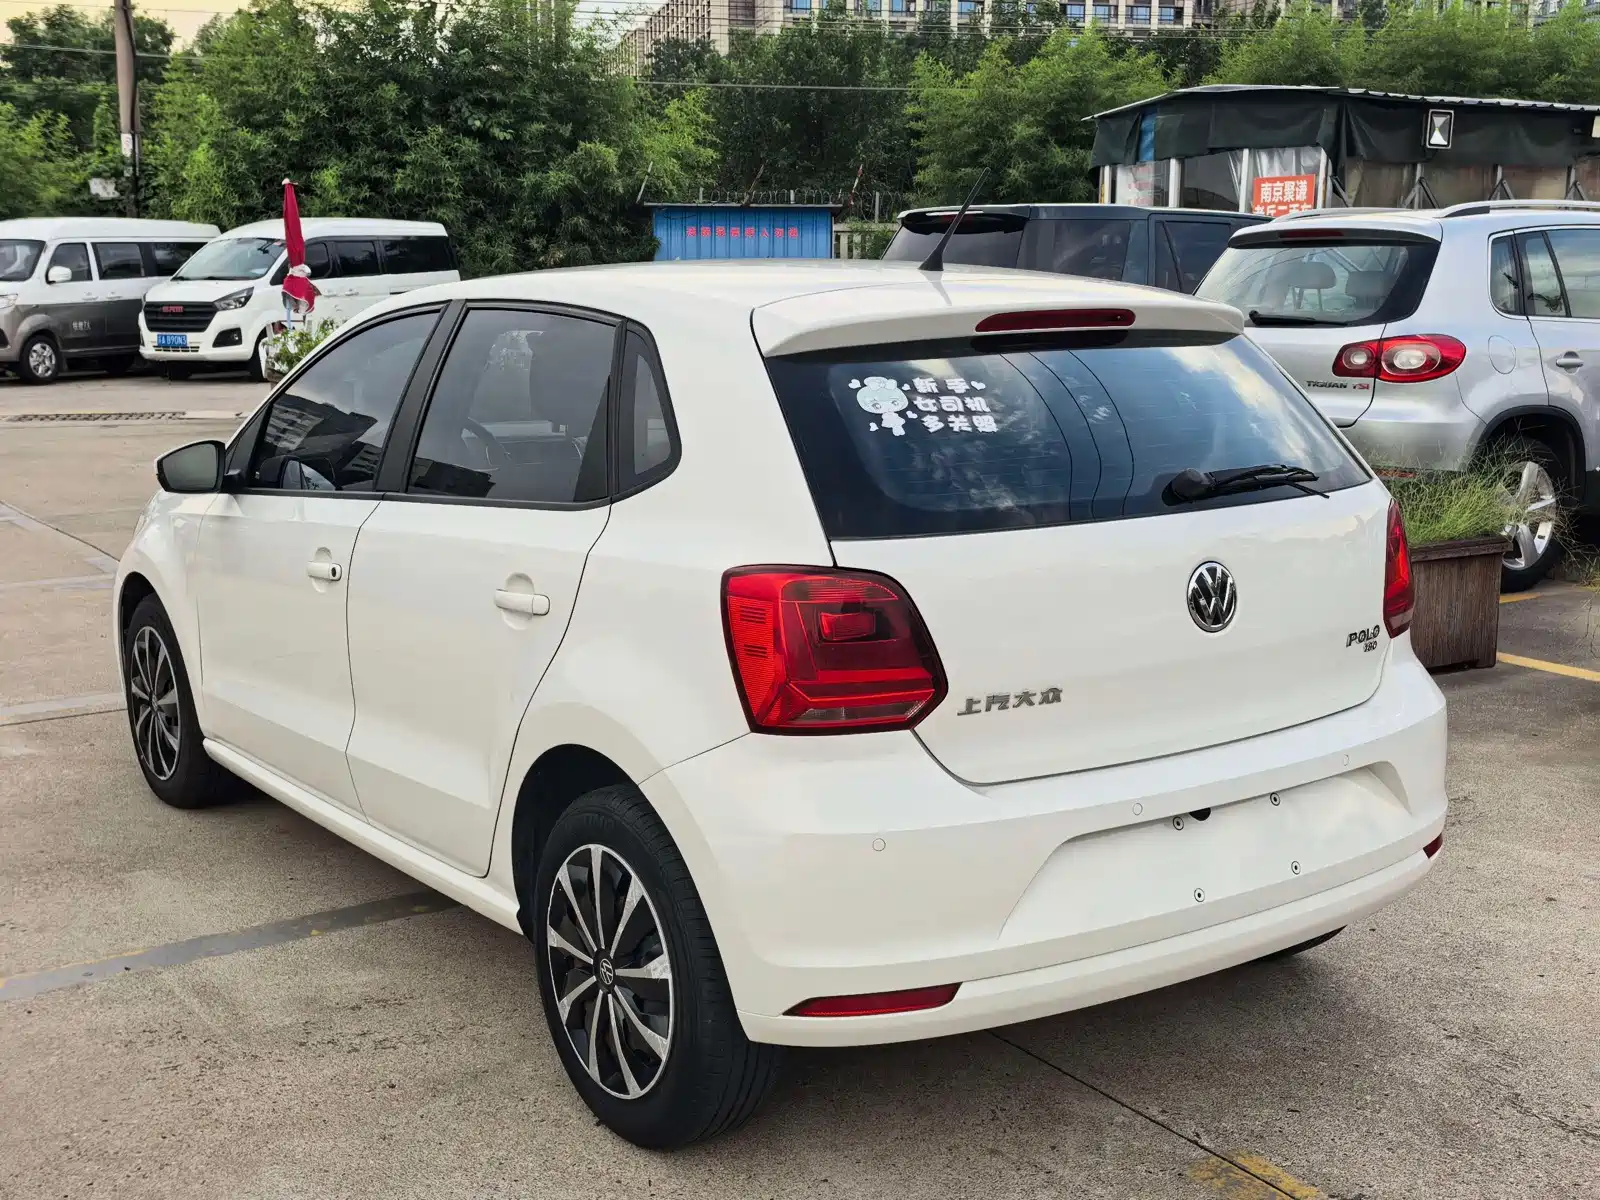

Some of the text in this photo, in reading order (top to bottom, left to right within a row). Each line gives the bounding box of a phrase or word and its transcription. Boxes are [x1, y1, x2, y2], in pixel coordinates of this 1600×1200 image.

[912, 377, 970, 394] 新手
[1306, 380, 1348, 389] TIGUAN
[913, 396, 991, 412] 女司机
[921, 414, 999, 433] 多关照
[1346, 624, 1380, 648] POLO
[957, 687, 1063, 716] 上汽大众
